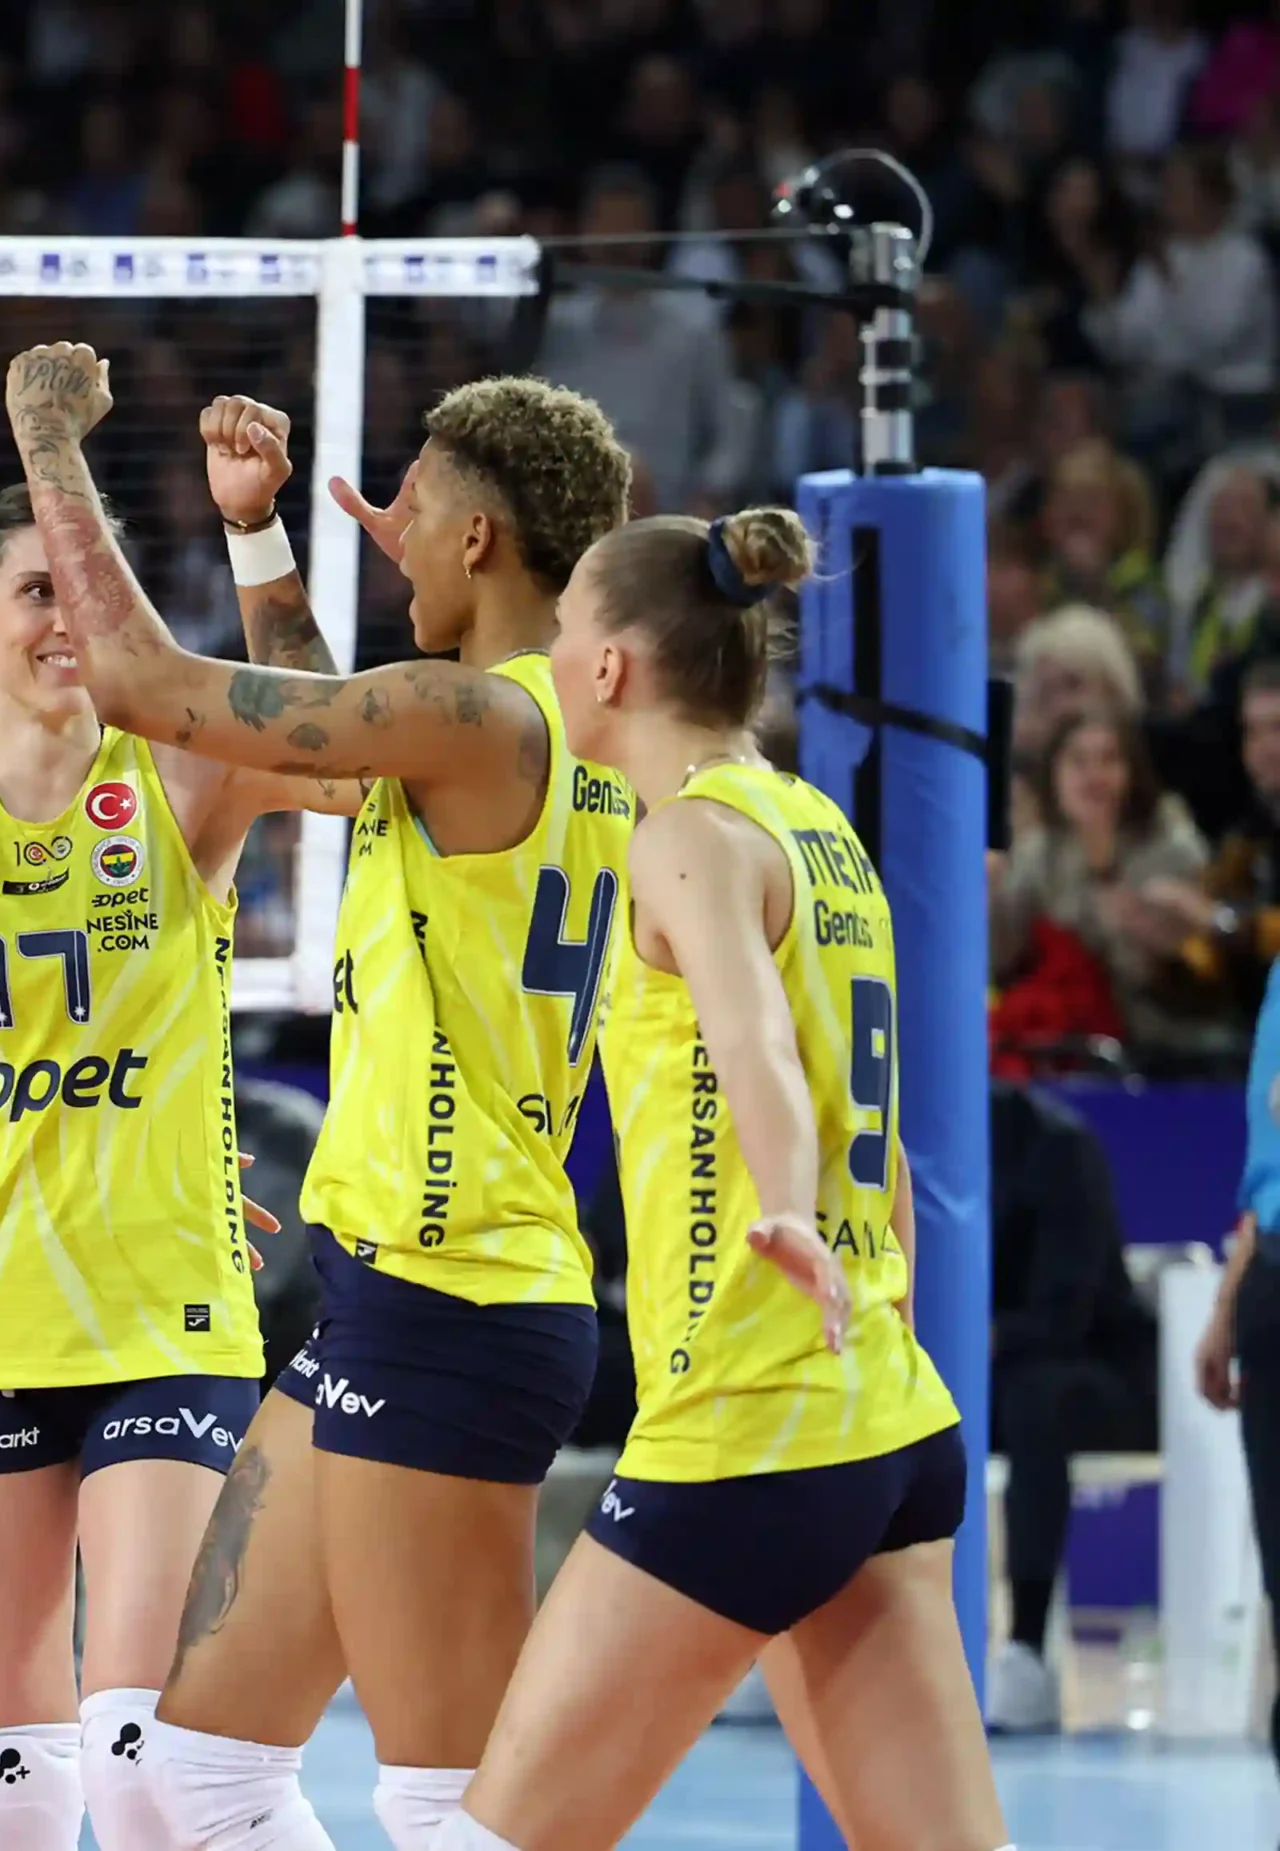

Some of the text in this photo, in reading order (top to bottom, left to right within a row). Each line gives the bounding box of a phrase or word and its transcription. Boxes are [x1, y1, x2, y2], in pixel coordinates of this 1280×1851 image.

[91, 887, 149, 908] opet
[97, 934, 150, 952] .COM
[522, 863, 619, 1068] 4
[848, 983, 896, 1193] 9
